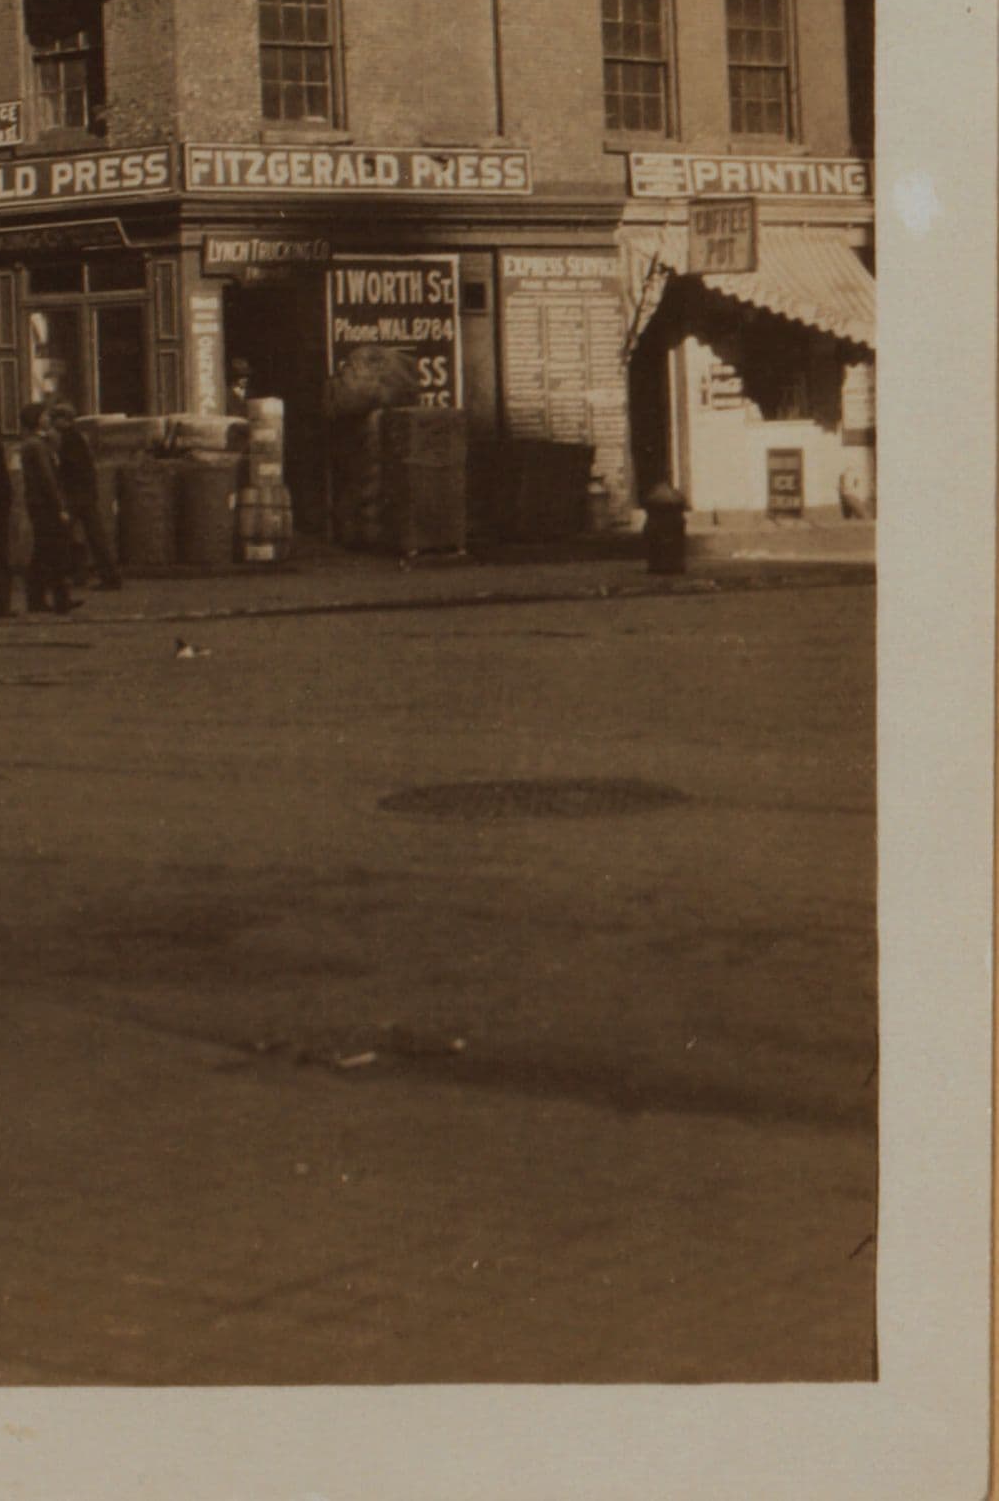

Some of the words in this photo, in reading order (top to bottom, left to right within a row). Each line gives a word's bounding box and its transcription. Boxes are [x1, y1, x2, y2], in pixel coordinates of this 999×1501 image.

[52, 152, 168, 195] PRESS
[191, 150, 399, 186] FITZGERALD
[411, 154, 527, 188] PRESS
[693, 160, 867, 195] PRINTING
[208, 239, 248, 263] LYNCH
[347, 270, 423, 305] WORTH
[334, 318, 378, 342] Phone
